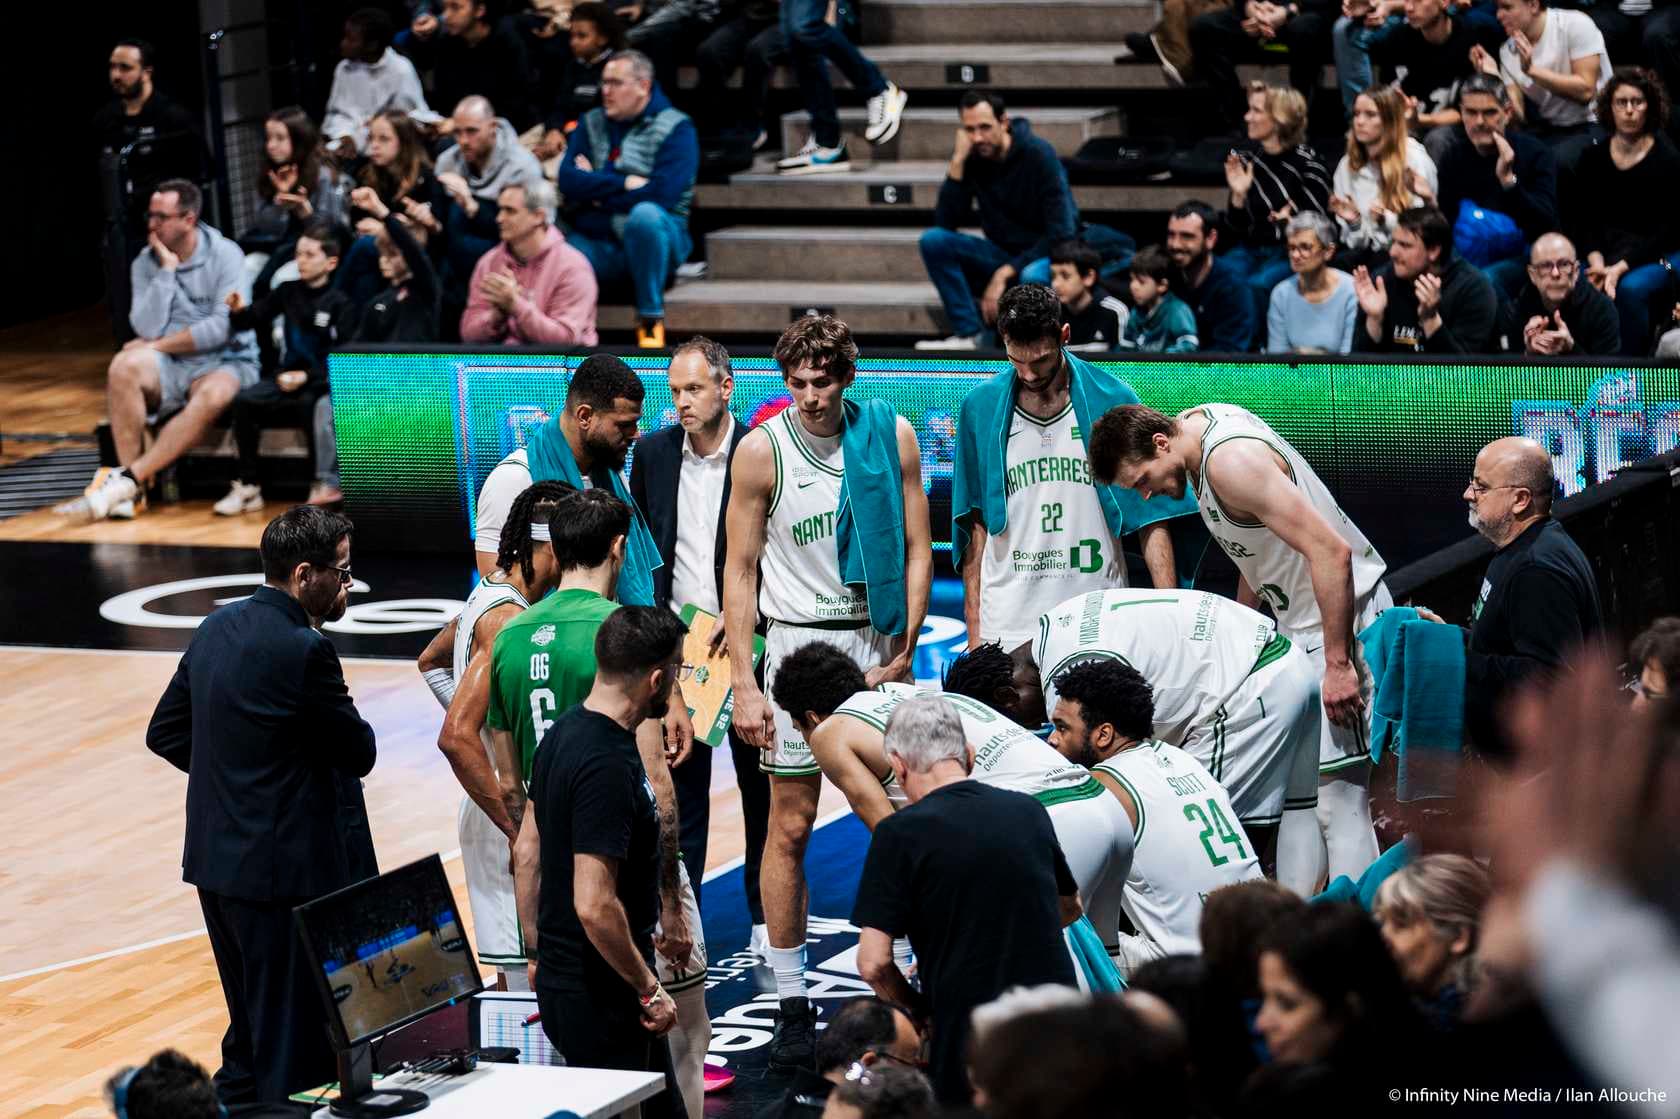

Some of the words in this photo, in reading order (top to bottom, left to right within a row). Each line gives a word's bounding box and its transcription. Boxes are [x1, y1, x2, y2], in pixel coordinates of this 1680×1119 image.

[1041, 503, 1063, 533] 22
[1013, 550, 1064, 561] Bouygues
[1014, 559, 1067, 572] Immobilier
[1166, 772, 1206, 796] SCOTT
[1183, 799, 1247, 867] 24
